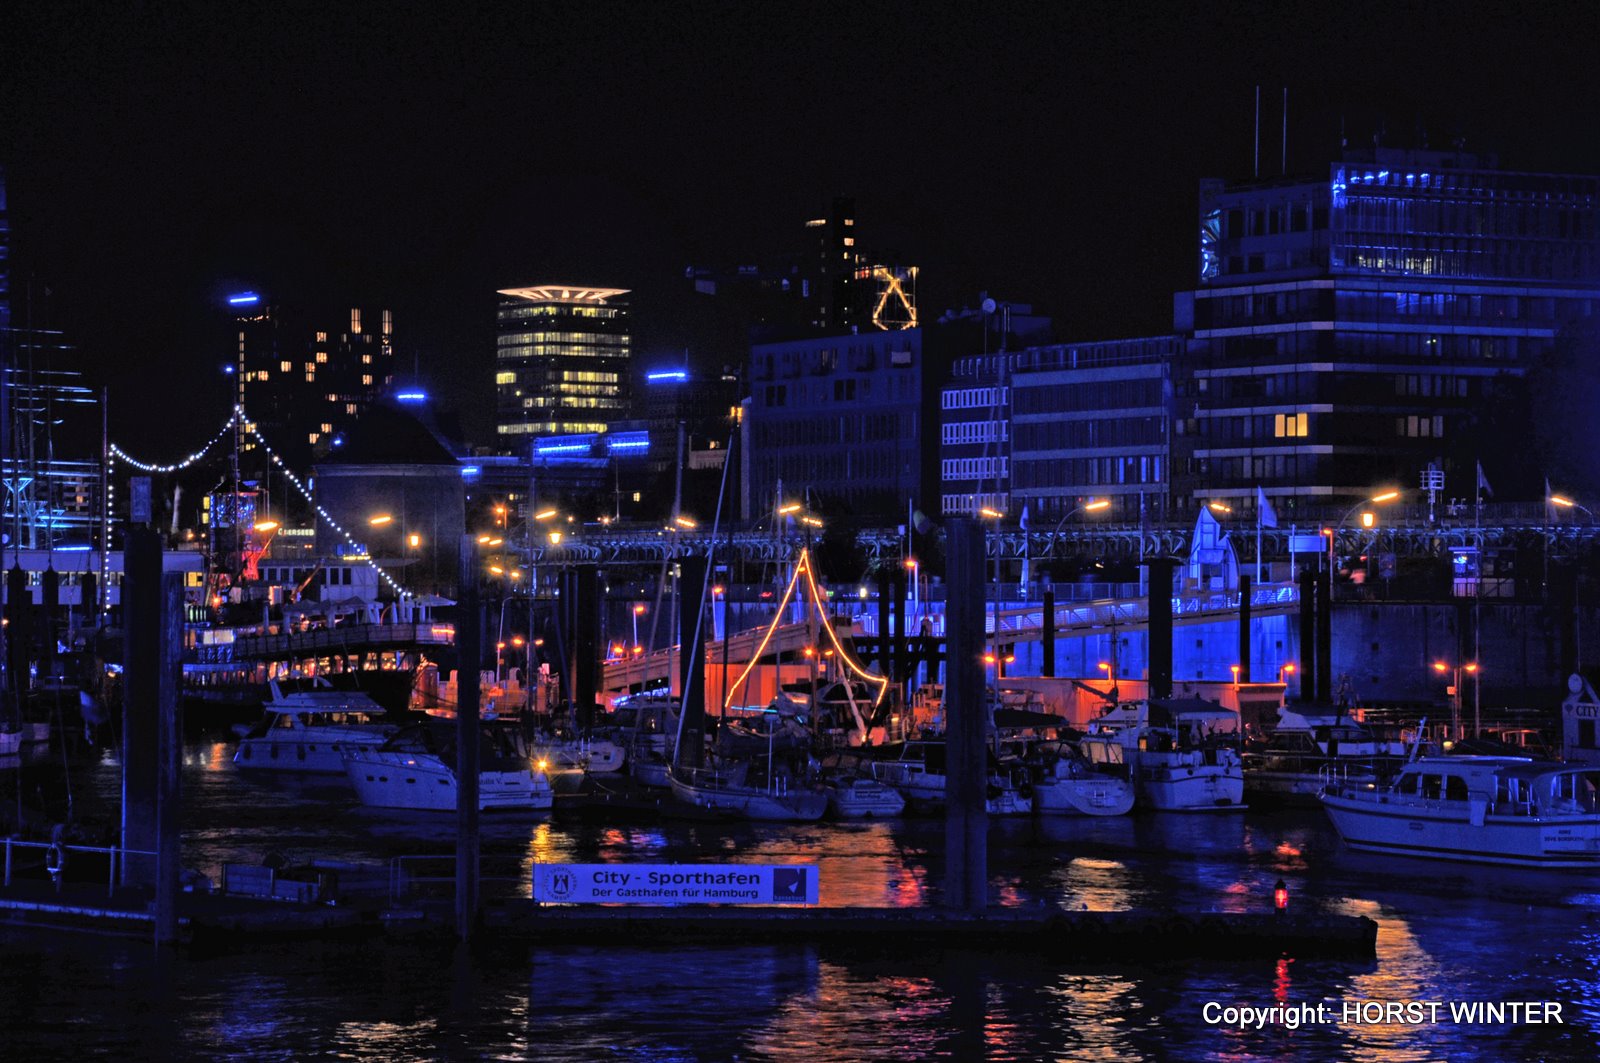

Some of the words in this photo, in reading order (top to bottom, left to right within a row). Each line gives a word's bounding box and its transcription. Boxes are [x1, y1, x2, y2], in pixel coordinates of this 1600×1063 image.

[1576, 705, 1599, 718] CITY
[592, 871, 631, 886] City
[648, 871, 761, 886] Sporthafen
[592, 888, 612, 897] Der
[616, 888, 679, 898] Gasthafen
[682, 888, 700, 897] für
[703, 888, 760, 899] Hamburg
